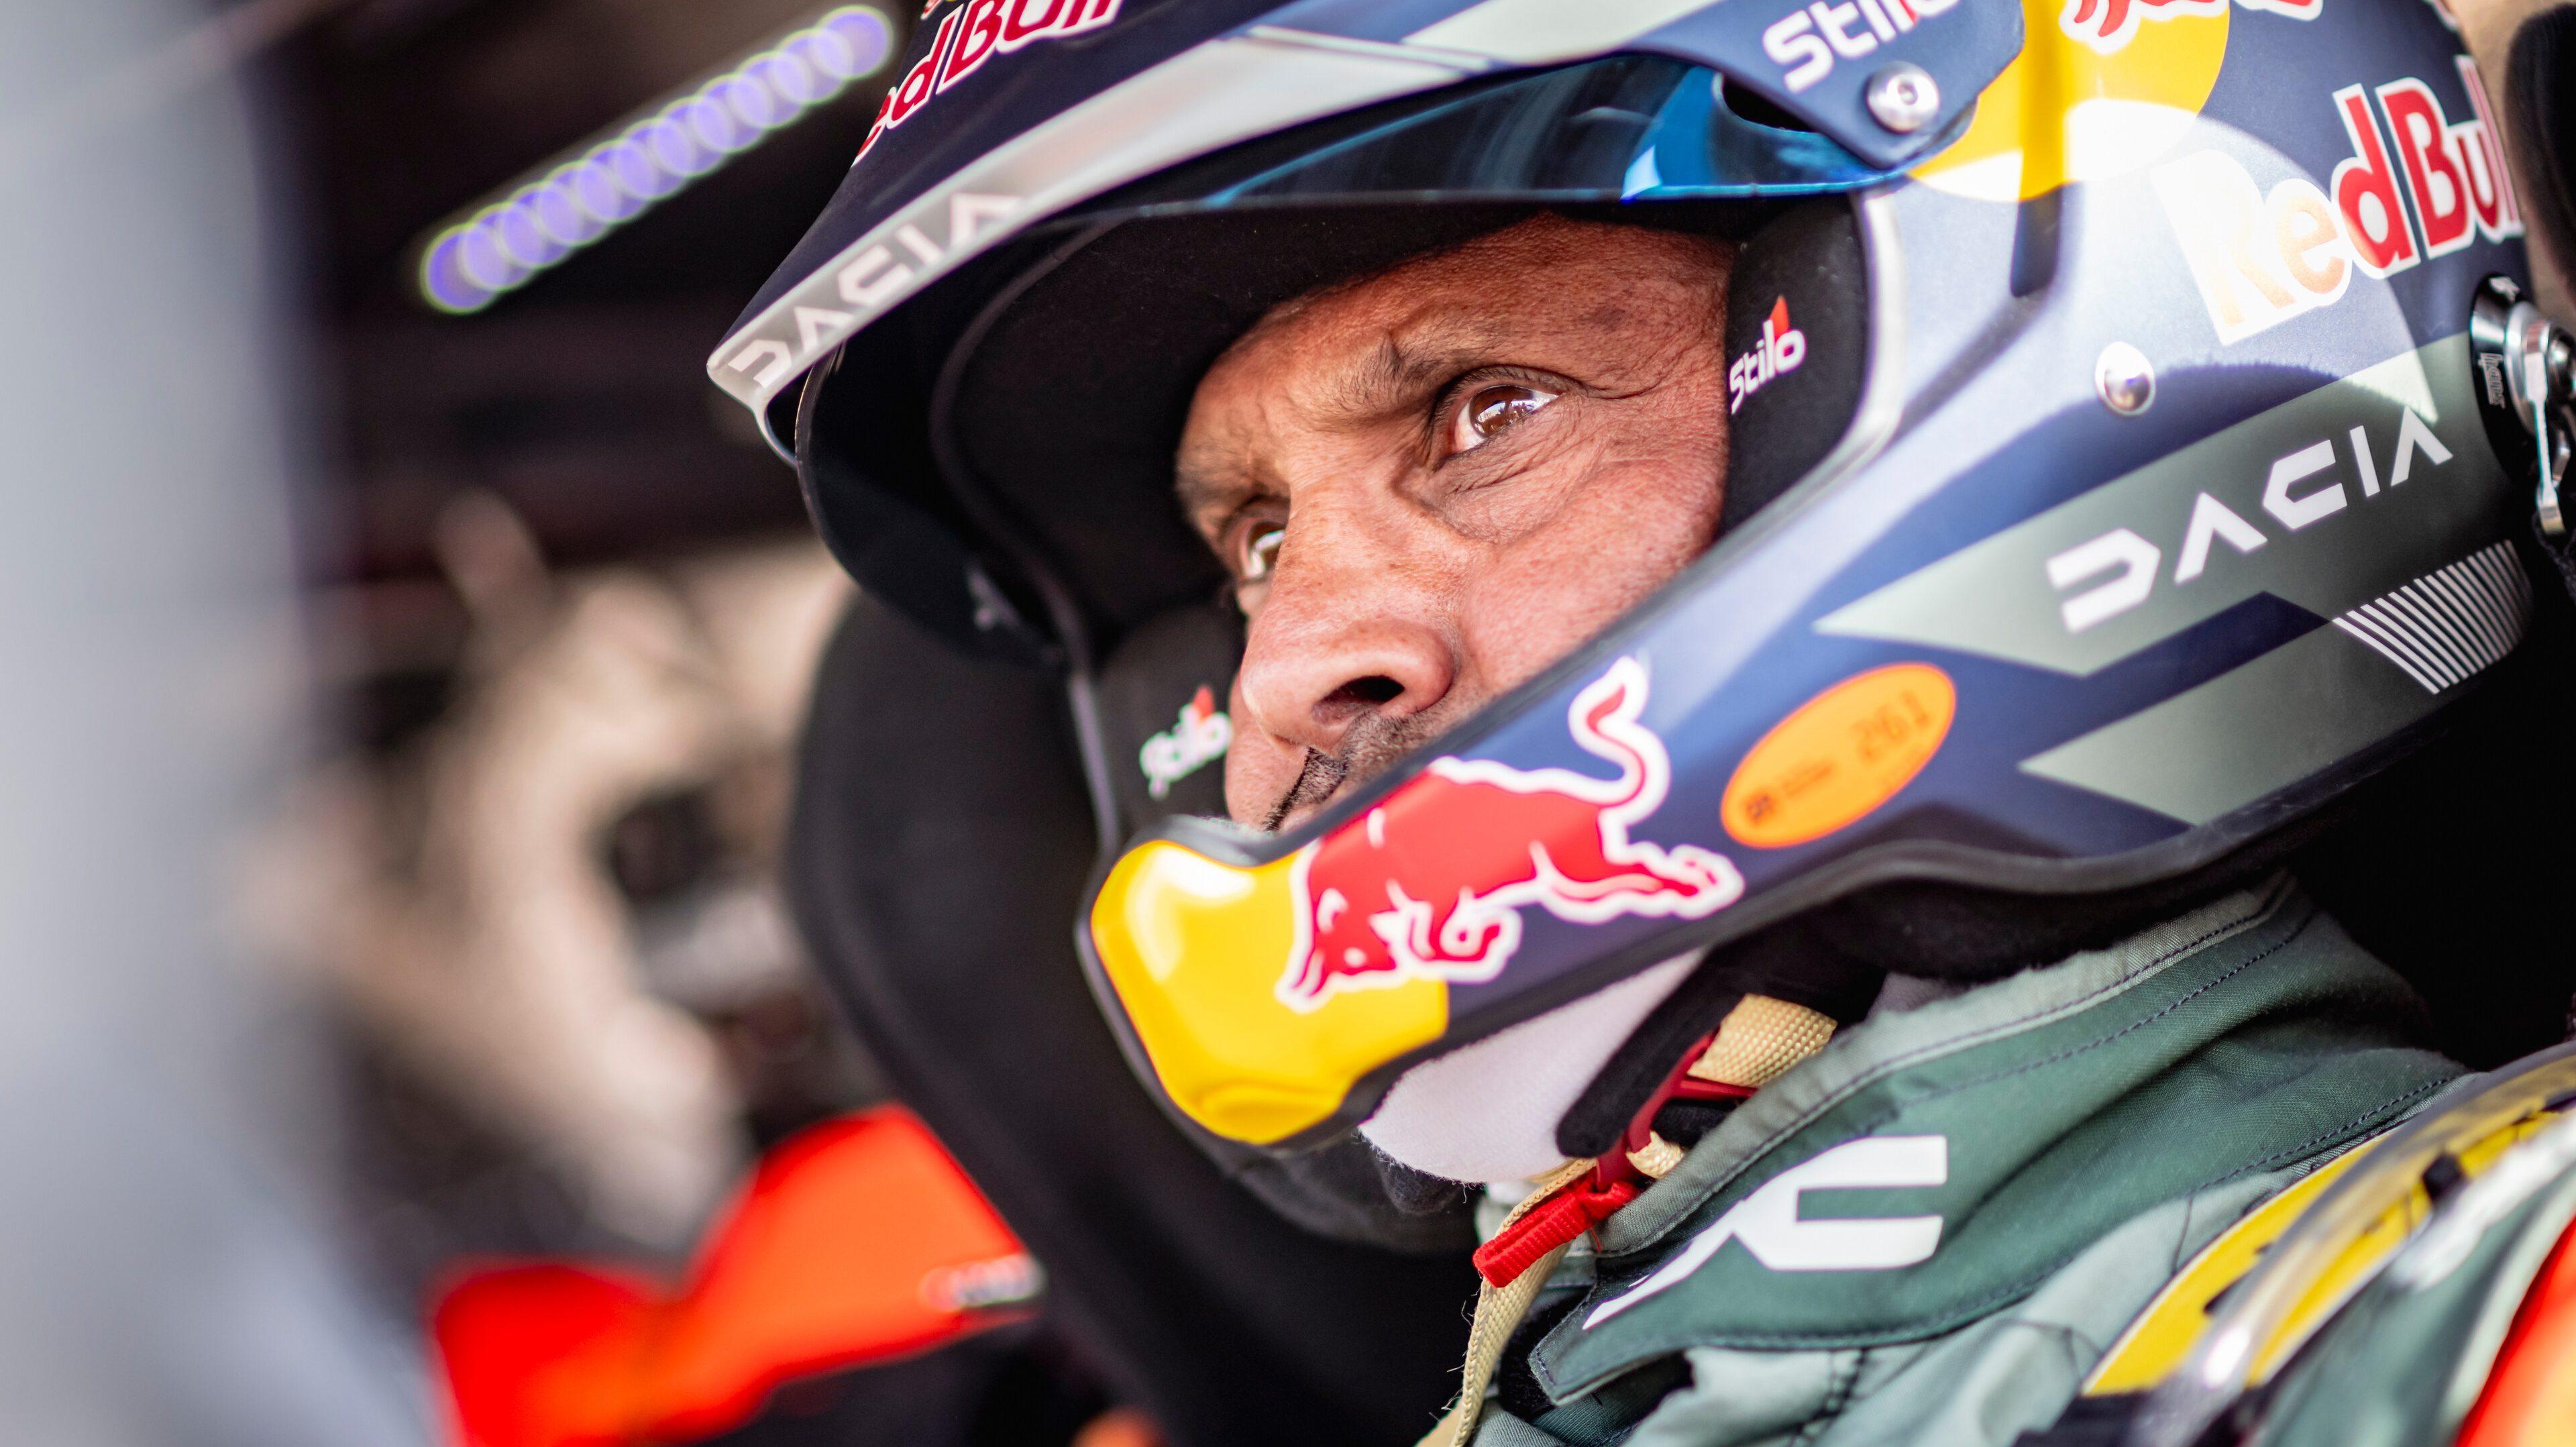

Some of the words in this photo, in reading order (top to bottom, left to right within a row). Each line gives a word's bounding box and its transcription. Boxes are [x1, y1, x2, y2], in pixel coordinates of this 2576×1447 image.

[727, 193, 1024, 389] DACIA
[2150, 83, 2420, 346] Red
[1729, 318, 1807, 415] Stilo
[2046, 405, 2453, 633] DACIA
